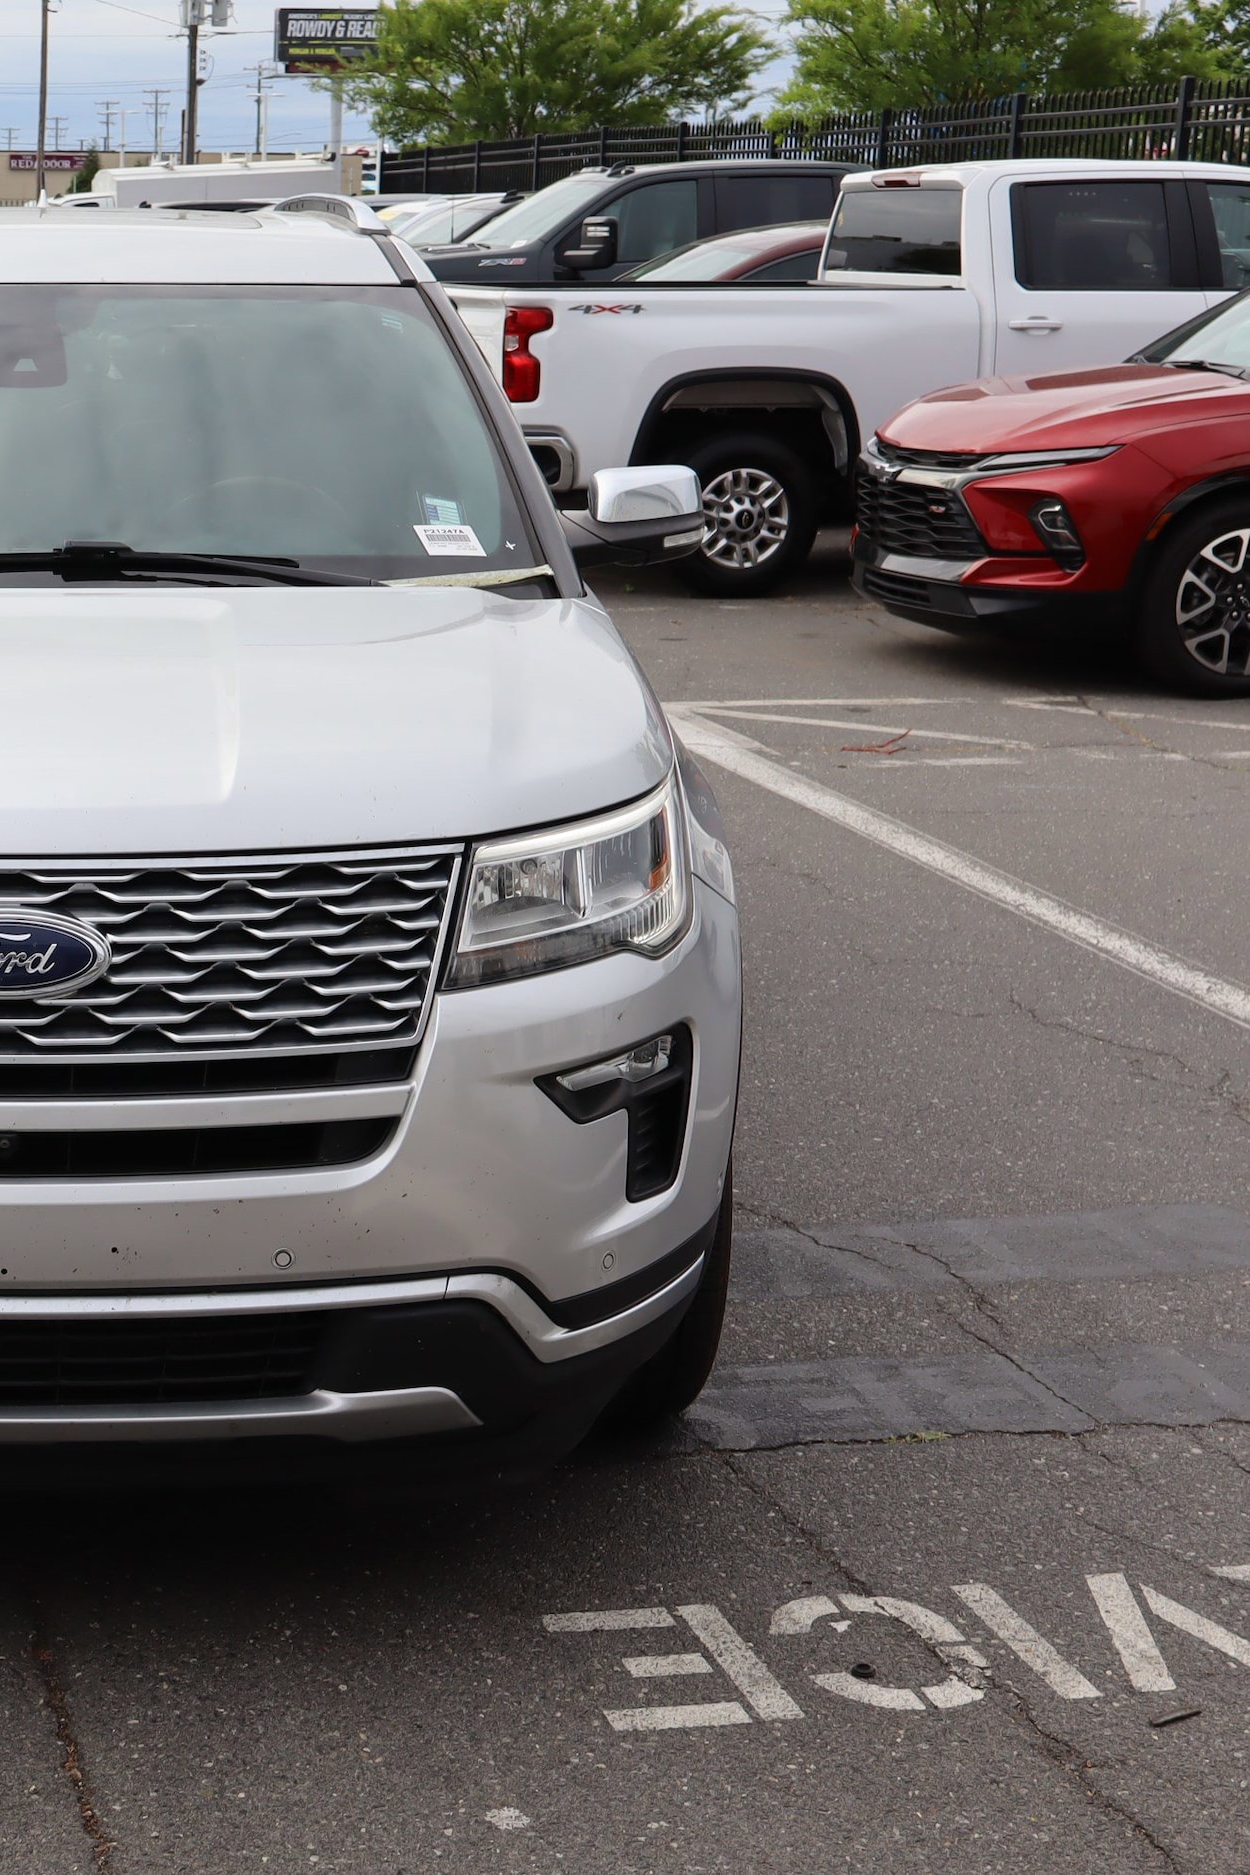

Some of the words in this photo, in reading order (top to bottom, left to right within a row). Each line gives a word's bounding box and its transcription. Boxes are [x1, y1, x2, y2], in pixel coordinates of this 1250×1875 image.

[287, 20, 335, 38] ROWDY
[347, 20, 386, 38] READ
[10, 159, 34, 169] RED
[44, 159, 71, 169] DOOR
[542, 1566, 1250, 1732] VICE
